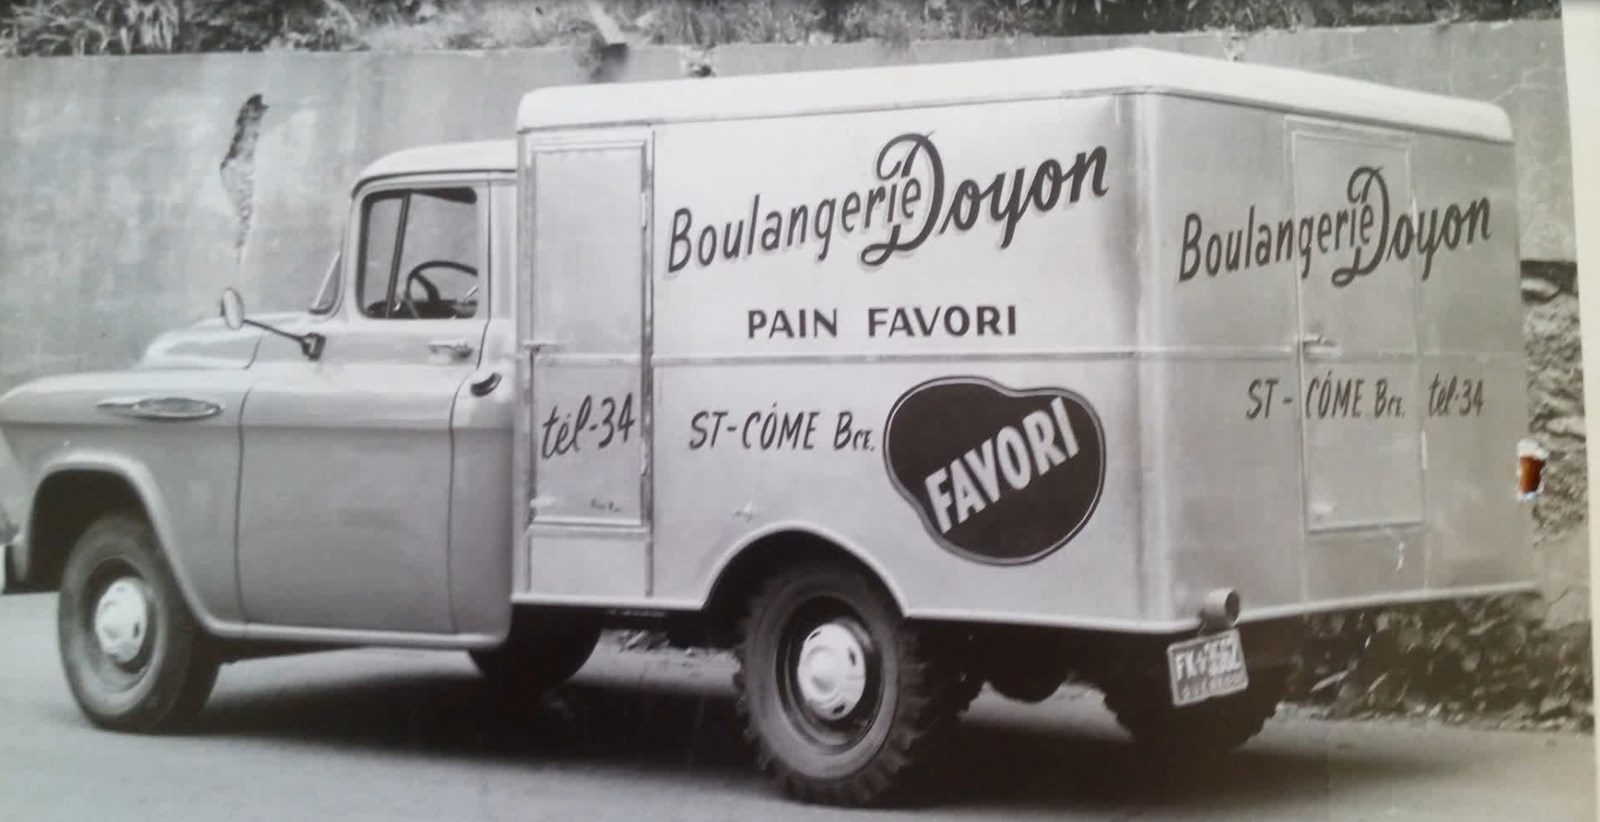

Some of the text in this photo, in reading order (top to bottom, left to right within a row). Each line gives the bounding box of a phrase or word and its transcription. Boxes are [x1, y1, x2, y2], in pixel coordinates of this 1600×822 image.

[668, 130, 1109, 273] Boulangerie Doyon
[1179, 165, 1492, 288] Boulangerie Doyon
[748, 305, 1017, 339] PAIN FAVORI
[924, 396, 1079, 534] FAVORI
